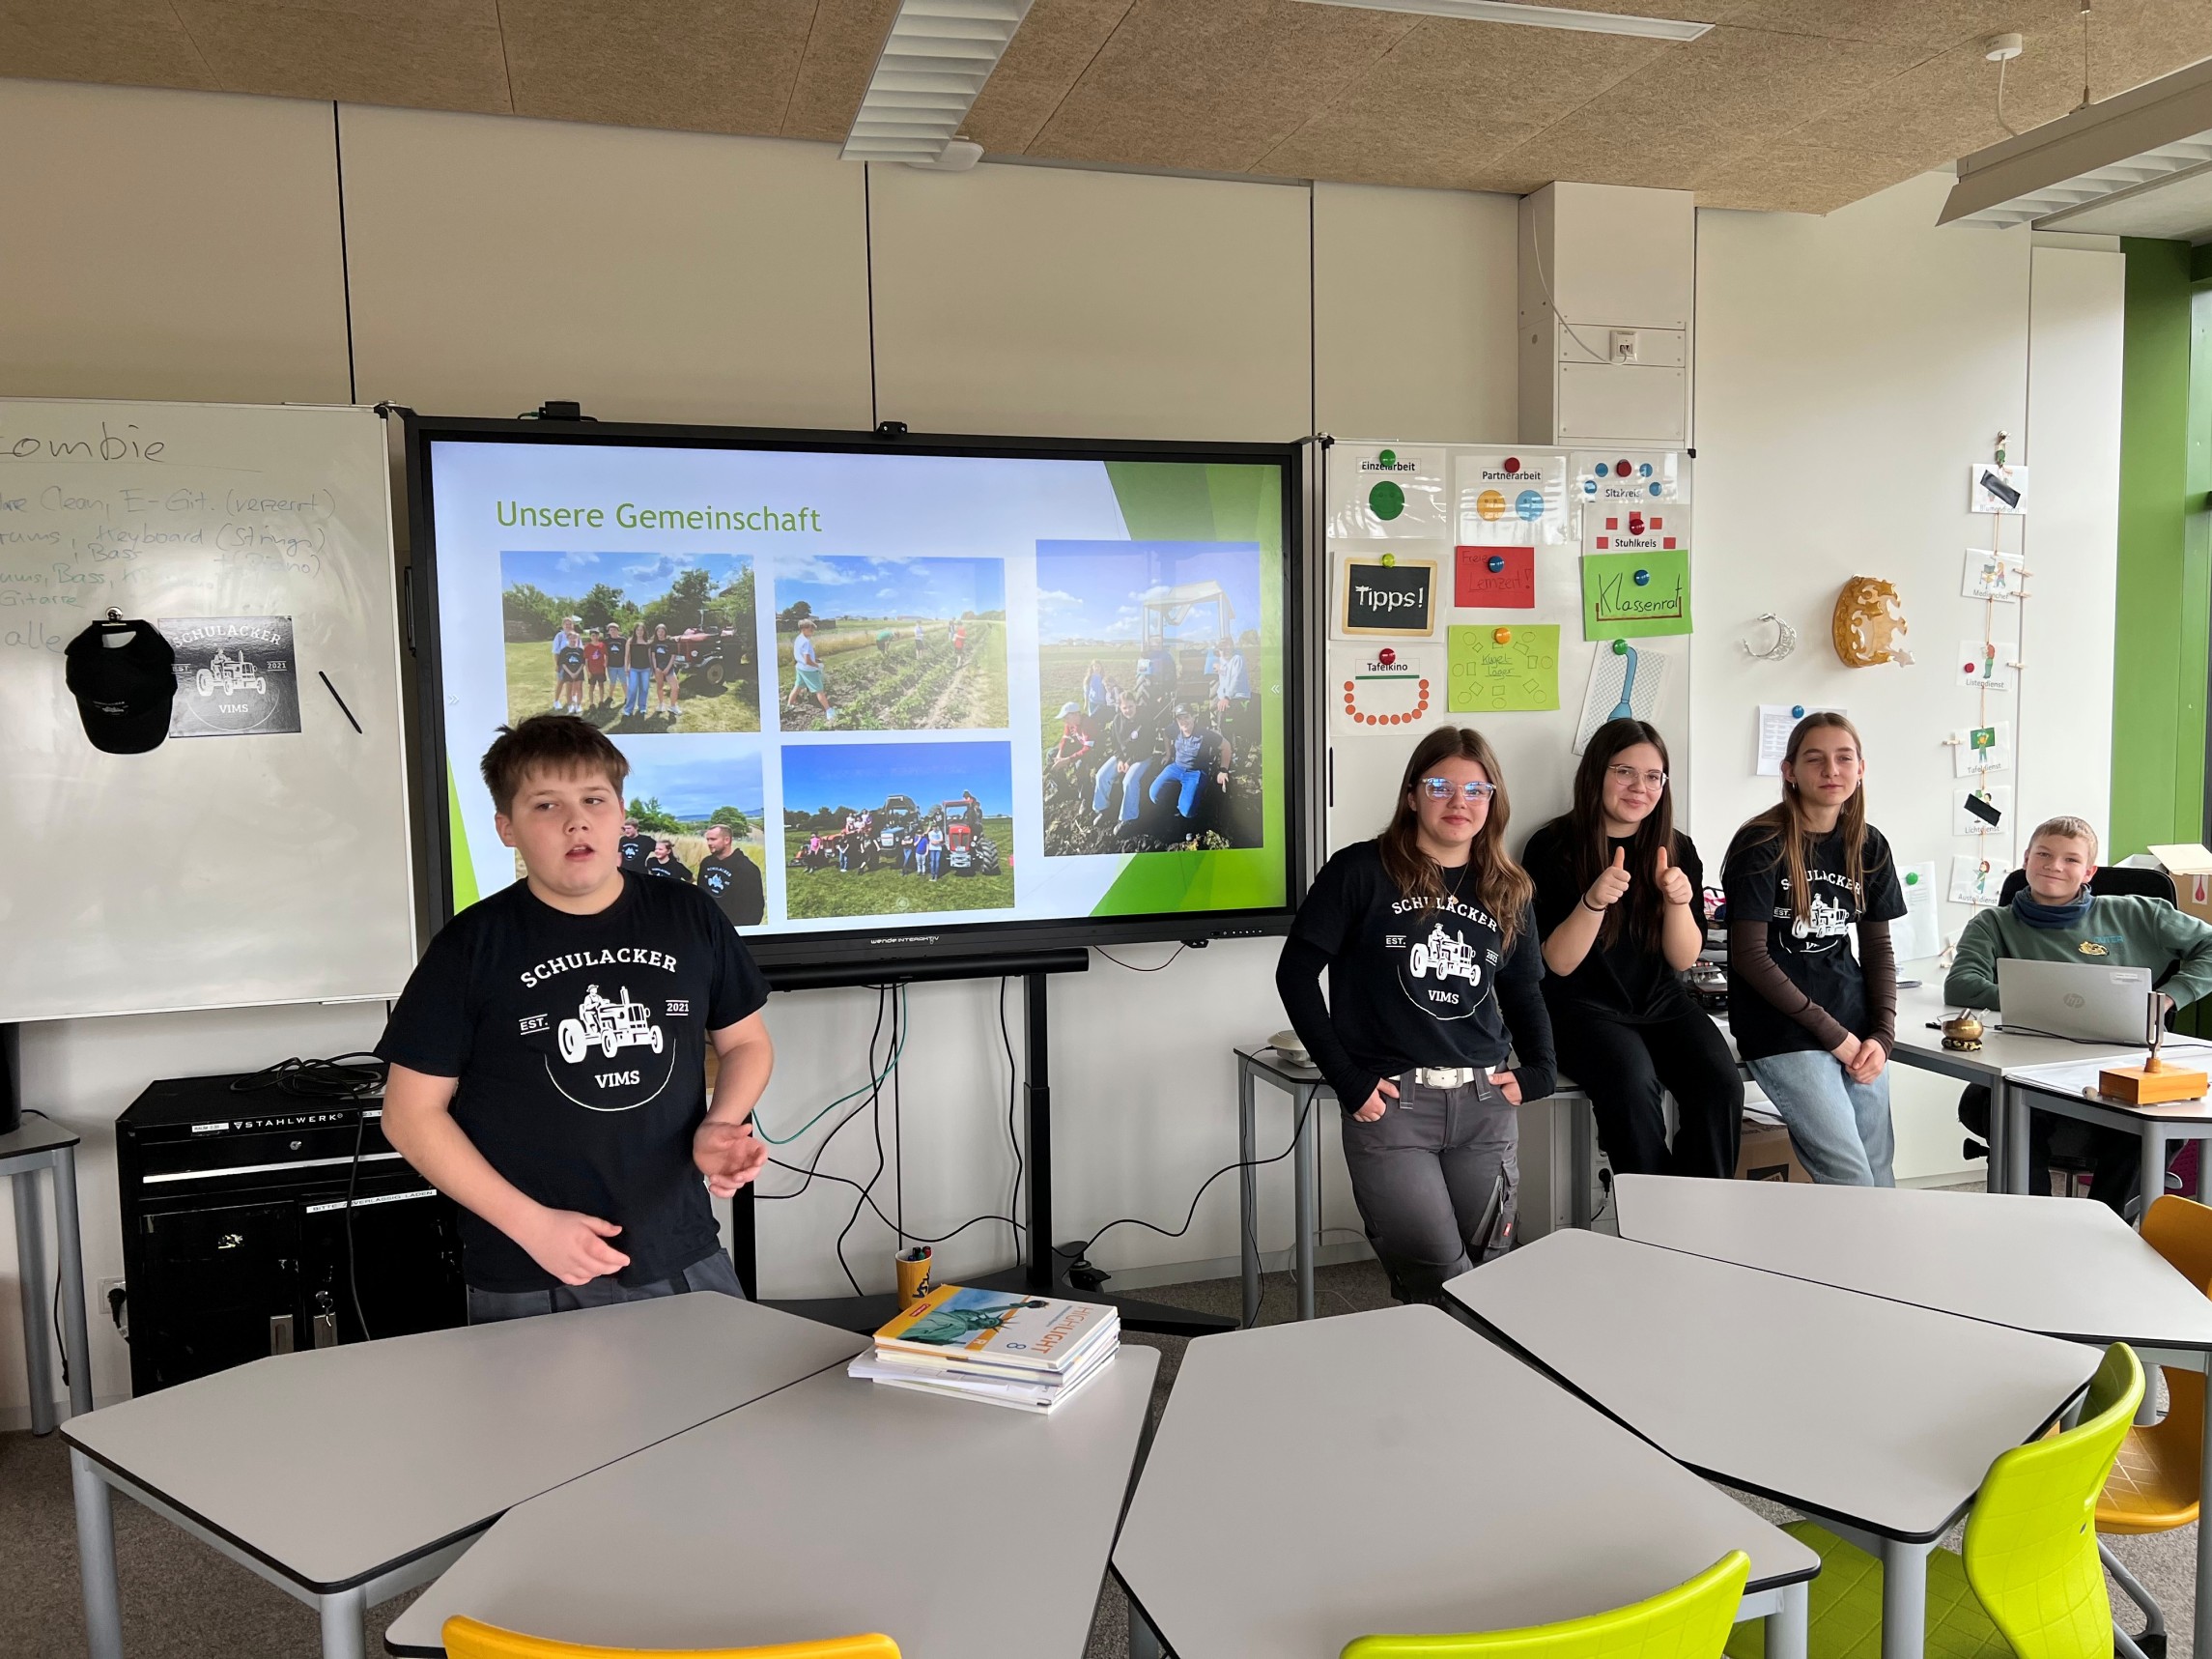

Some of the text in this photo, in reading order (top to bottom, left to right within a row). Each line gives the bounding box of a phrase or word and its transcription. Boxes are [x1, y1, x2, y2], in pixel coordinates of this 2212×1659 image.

[1482, 471, 1542, 480] Partnerarbeit
[1604, 488, 1641, 498] Sitzkreis
[496, 501, 822, 532] Unsere Gemeinschaft
[1615, 538, 1657, 548] Stuhlkreis
[1354, 586, 1424, 612] Tipps!
[1599, 572, 1682, 615] Klassenrat
[173, 624, 281, 647] SCHULACKER
[1367, 662, 1408, 672] Tafelkino
[1966, 678, 2004, 689] Listendienst
[218, 704, 248, 714] VIMS
[1968, 762, 2001, 774] Tafeldienst
[1781, 869, 1862, 896] SULACKER
[1773, 908, 1791, 917] EST.
[1486, 952, 1498, 963] 2021
[520, 948, 677, 988] SCHULACKER
[1428, 989, 1460, 1005] VIMS
[520, 1002, 690, 1031] EST. 2021
[594, 1070, 640, 1089] VIMS
[405, 1190, 433, 1199] LADEN
[1031, 1306, 1093, 1355] HIGHLIGHT
[1007, 1342, 1027, 1351] 8
